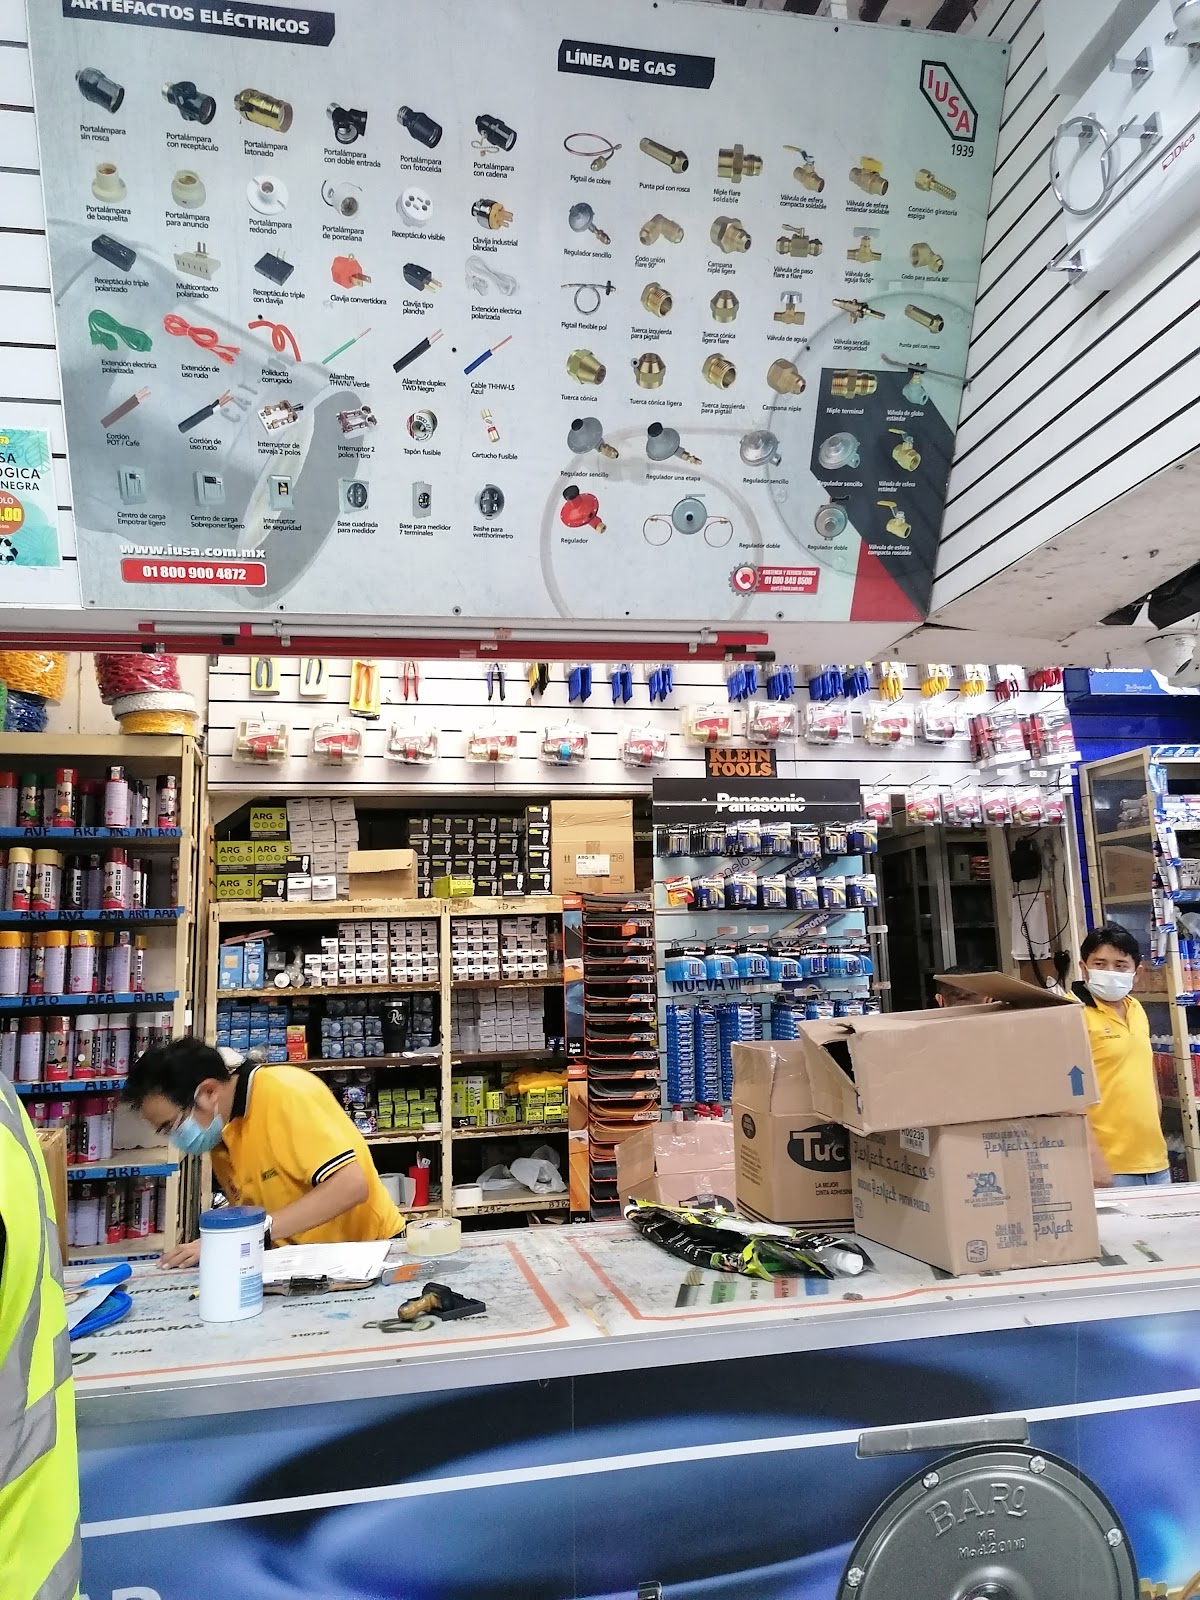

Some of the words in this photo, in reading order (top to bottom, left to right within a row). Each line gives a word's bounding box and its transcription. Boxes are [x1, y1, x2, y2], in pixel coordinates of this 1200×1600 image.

[71, 0, 194, 20] ARTEFACTOS
[200, 8, 310, 34] ELÉCTRICOS
[566, 48, 614, 69] LÍNEA
[619, 58, 639, 72] DE
[644, 62, 676, 76] GAS
[928, 69, 970, 133] IUSA
[80, 125, 126, 135] Portalámpara
[166, 132, 212, 143] Portalámpara
[244, 148, 274, 157] latonado
[324, 148, 366, 158] Portalámpara
[951, 144, 974, 157] 1939
[400, 155, 442, 165] Portalámpara
[473, 162, 514, 172] Portalámpara
[570, 175, 586, 184] Pigtail
[86, 205, 131, 215] Portalámpara
[165, 212, 210, 222] Portalámpara
[249, 219, 292, 229] Portalámpara
[249, 227, 277, 235] redondo
[322, 225, 364, 235] Portalámpara
[392, 231, 426, 240] Receptáculo
[428, 233, 445, 241] visible
[473, 237, 490, 245] Clavija
[492, 238, 518, 246] industrial
[473, 244, 497, 252] blindada
[176, 283, 218, 292] Multicontacto
[176, 291, 209, 299] polarizado
[253, 289, 288, 298] Receptáculo
[290, 291, 305, 299] triple
[267, 297, 284, 305] clavija
[472, 306, 498, 314] Extención
[500, 307, 522, 315] electrica
[471, 313, 500, 321] polarizada
[102, 360, 130, 368] Extención
[102, 367, 134, 375] polarizada
[262, 369, 288, 377] Poliducto
[402, 378, 426, 386] Alambre
[427, 380, 446, 388] duplex
[0, 468, 41, 479] GICA
[1, 481, 40, 490] NEGRA
[150, 519, 166, 527] ligero
[228, 522, 245, 530] ligero
[120, 544, 265, 558] www.iusa.com.mx
[143, 566, 158, 578] 01
[161, 567, 185, 578] 800
[189, 568, 213, 579] 900
[216, 569, 246, 580] 4872
[709, 749, 771, 762] KLEIN
[709, 762, 773, 776] TOOLS
[716, 792, 806, 813] Panasonic
[253, 812, 286, 820] ARGS
[219, 846, 253, 854] ARGS
[256, 845, 290, 853] ARGS
[219, 879, 253, 887] ARGS
[793, 1131, 845, 1162] Tuc
